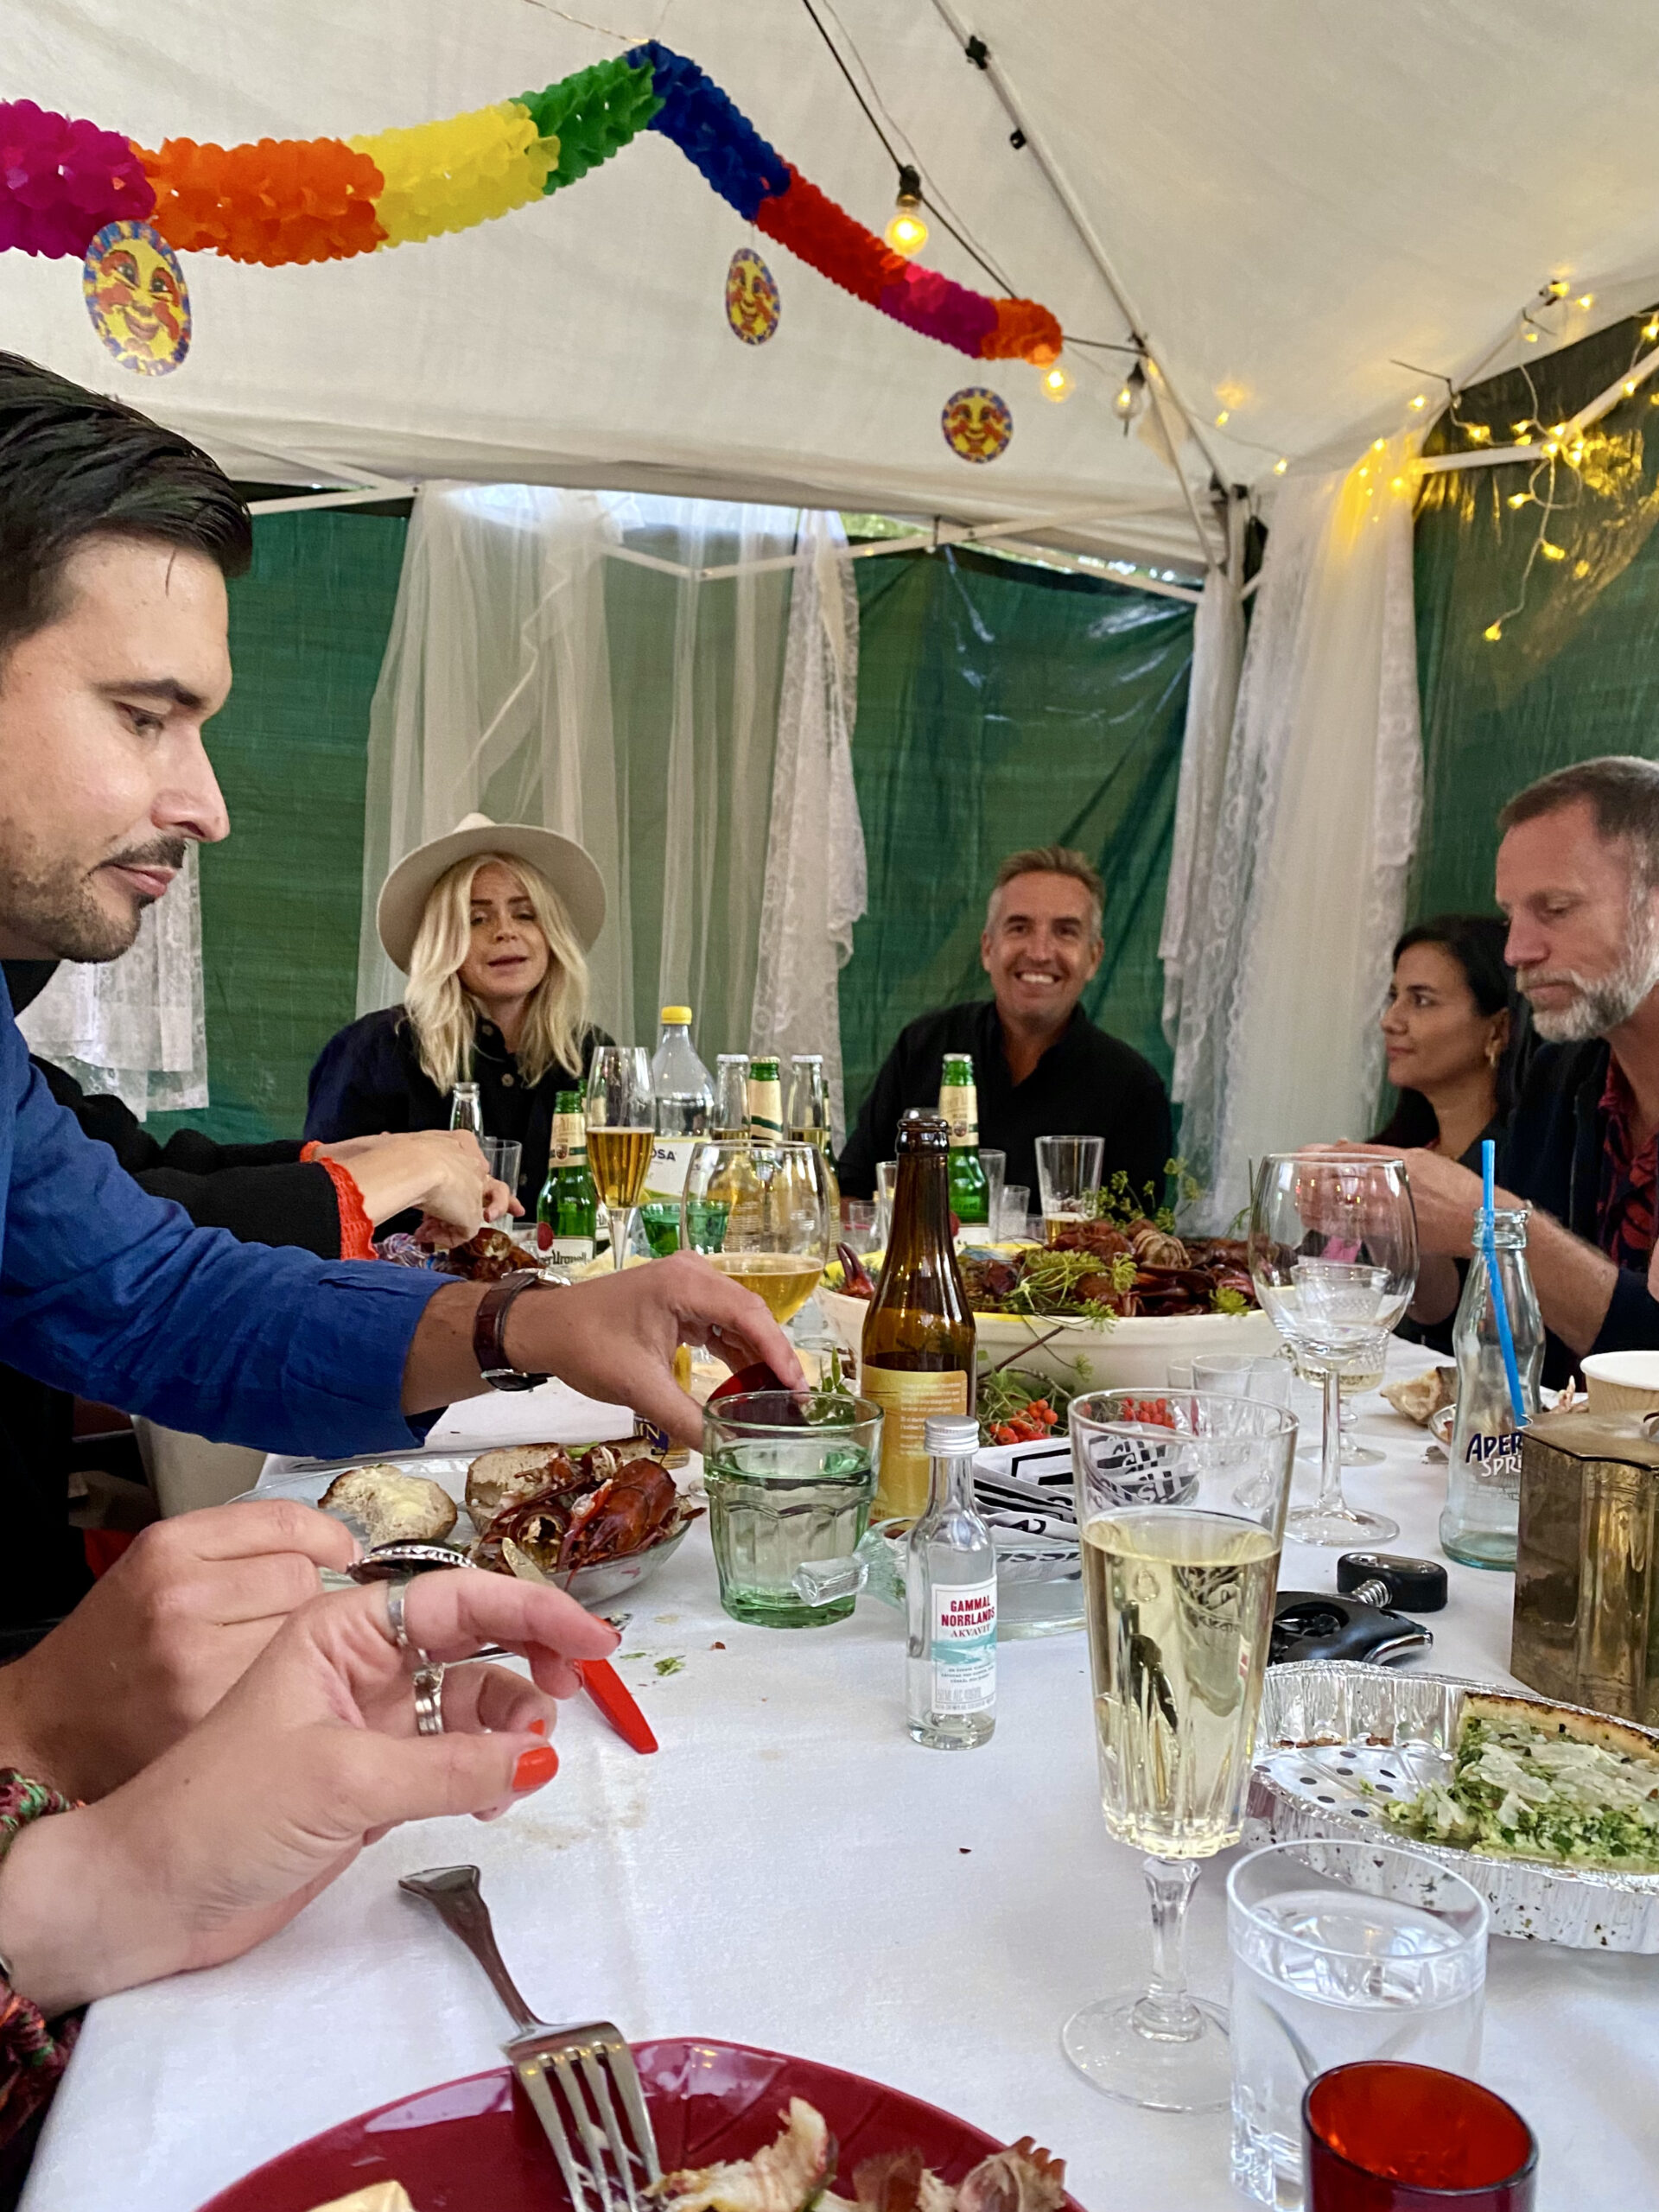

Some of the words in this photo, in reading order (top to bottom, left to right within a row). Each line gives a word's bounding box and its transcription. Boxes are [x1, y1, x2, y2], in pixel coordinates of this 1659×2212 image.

[1465, 1431, 1522, 1464] APER
[1481, 1455, 1522, 1478] SPRi
[950, 1595, 990, 1612] GAMMAL
[941, 1606, 995, 1627] NORRLANDS
[950, 1624, 990, 1638] AKVAVIT
